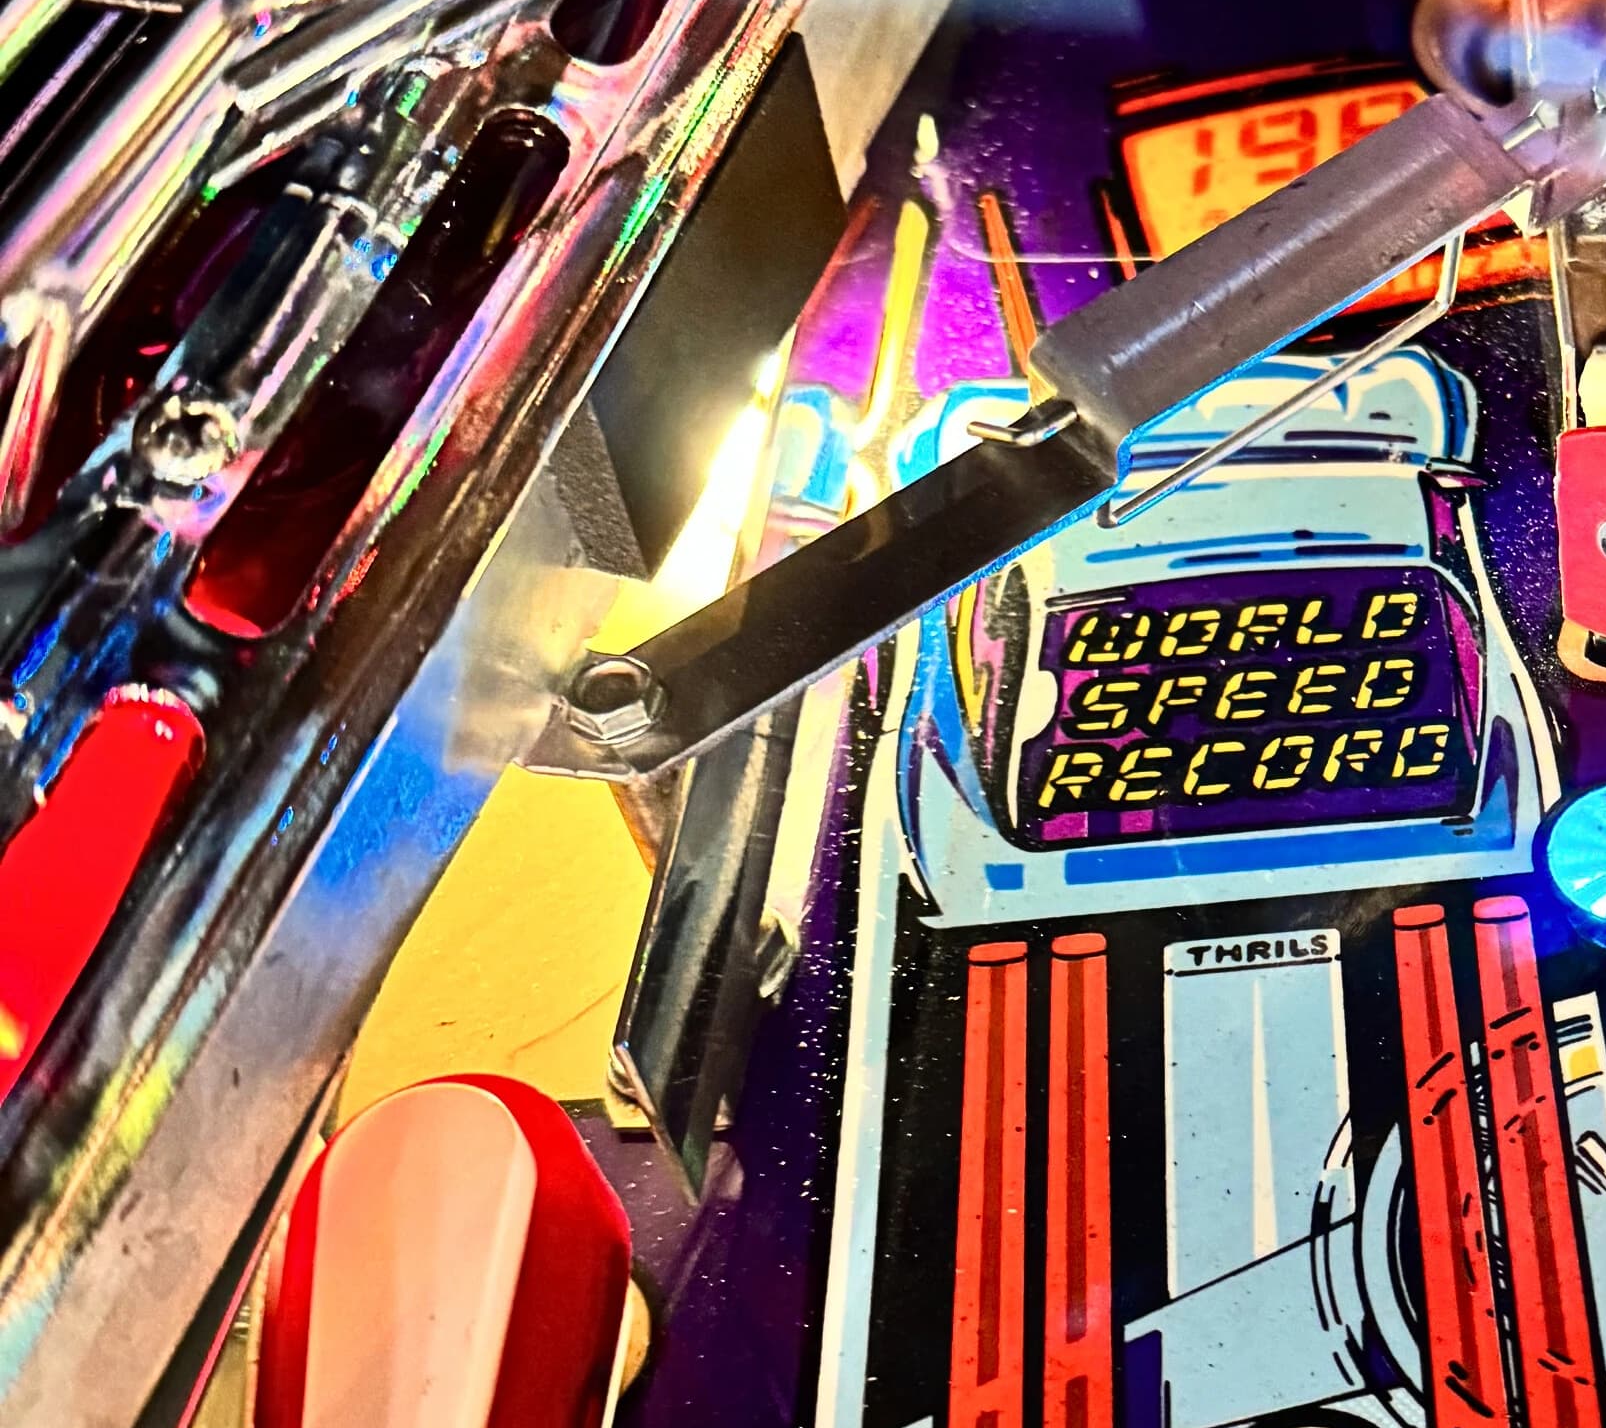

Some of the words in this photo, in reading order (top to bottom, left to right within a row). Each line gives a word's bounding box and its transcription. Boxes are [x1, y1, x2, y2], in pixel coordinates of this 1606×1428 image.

[1067, 592, 1420, 663] WORLD
[1077, 658, 1416, 731] SPEED
[1037, 724, 1451, 809] RECORD
[1187, 934, 1329, 967] THRILS
